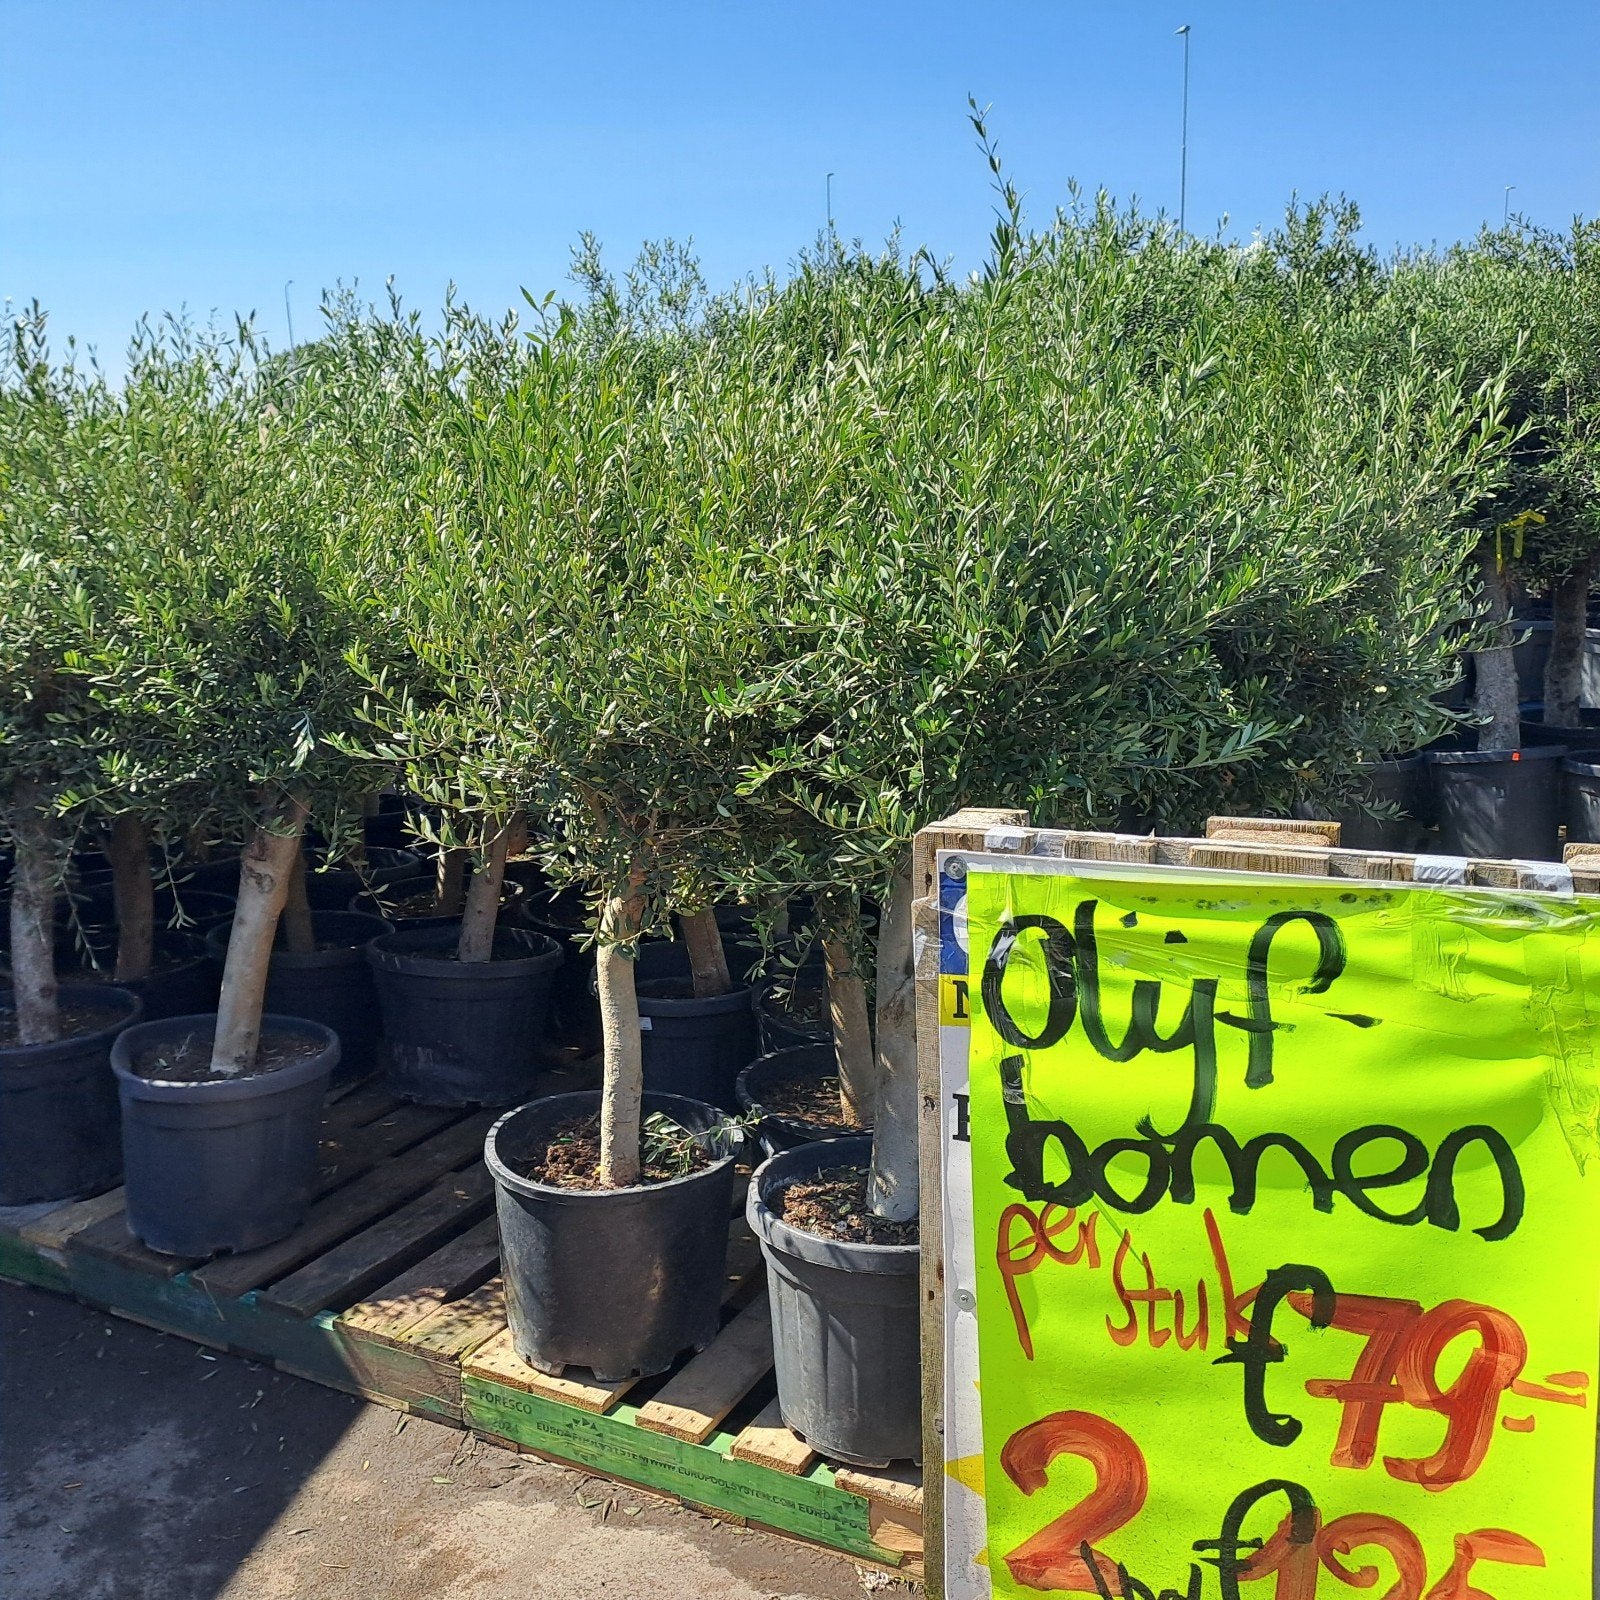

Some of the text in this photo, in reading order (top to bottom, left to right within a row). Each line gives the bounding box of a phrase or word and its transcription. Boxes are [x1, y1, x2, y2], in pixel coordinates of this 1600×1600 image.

[999, 1054, 1525, 1243] bomen
[996, 1201, 1101, 1361] per
[479, 1390, 532, 1415] FORESCO
[1000, 1410, 1149, 1597] 2
